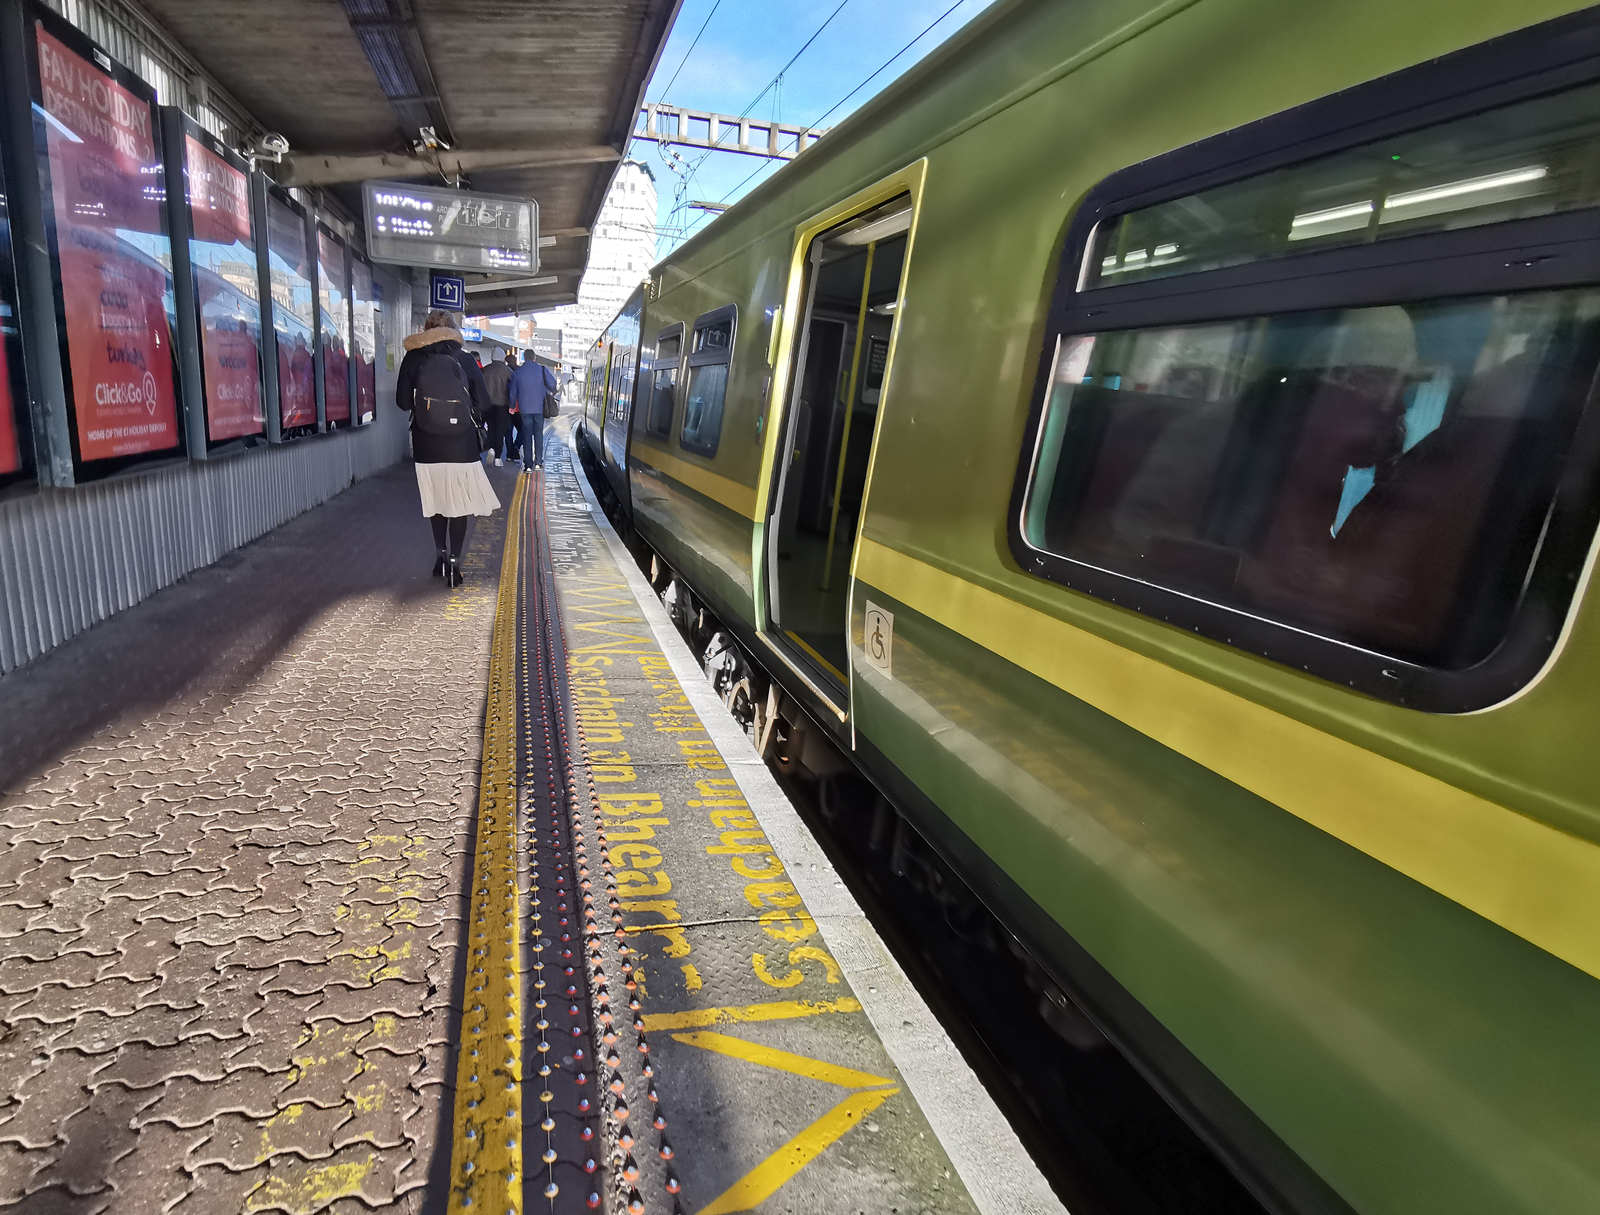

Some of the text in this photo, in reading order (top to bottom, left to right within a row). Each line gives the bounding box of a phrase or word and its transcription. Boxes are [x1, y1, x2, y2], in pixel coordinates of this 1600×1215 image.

[41, 42, 147, 139] FAV HOLIDAY
[95, 382, 142, 406] Click&Go
[590, 750, 637, 782] an
[677, 740, 727, 770] an
[687, 779, 840, 988] Seachain
